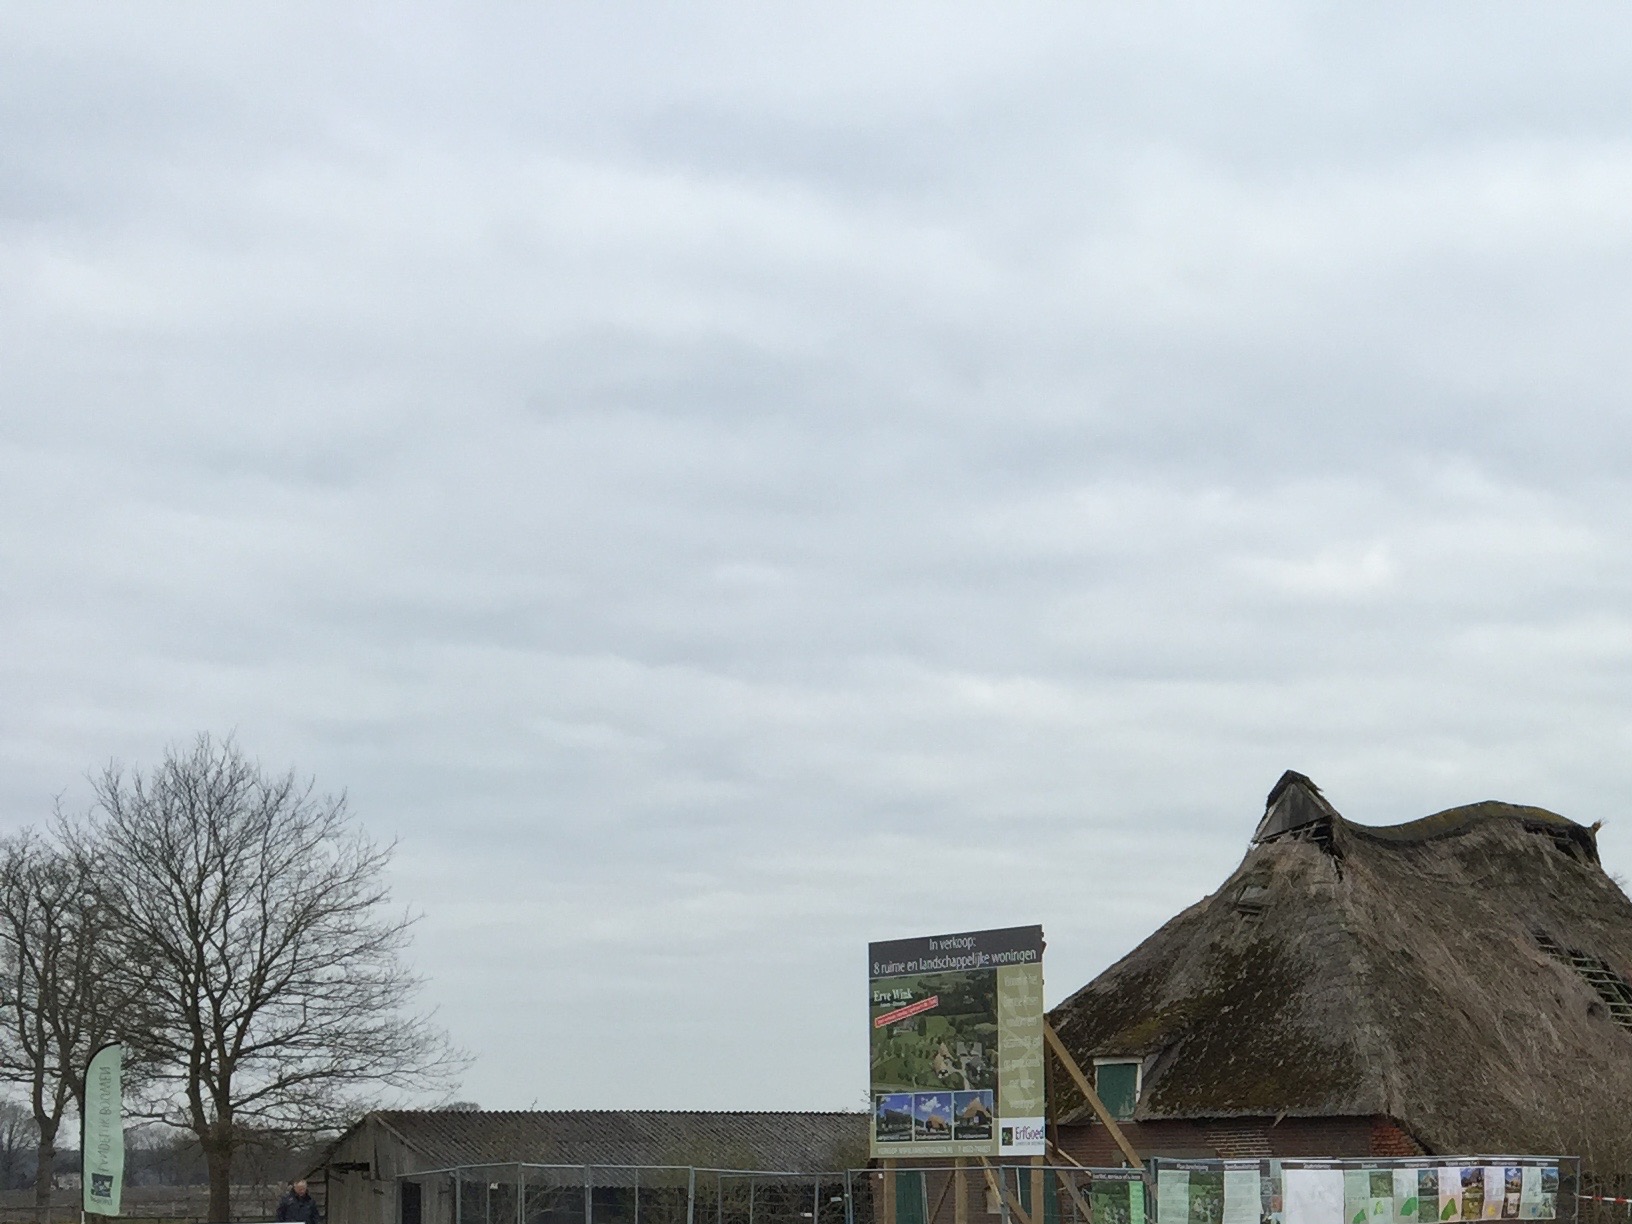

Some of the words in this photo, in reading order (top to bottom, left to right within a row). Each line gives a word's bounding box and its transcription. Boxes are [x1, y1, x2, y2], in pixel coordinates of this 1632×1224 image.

[929, 938, 938, 951] In
[939, 936, 977, 951] verkoop:
[873, 963, 880, 975] 8
[881, 960, 905, 974] ruime
[907, 961, 918, 972] en
[919, 951, 990, 971] landschappelijke
[991, 948, 1037, 964] woningen
